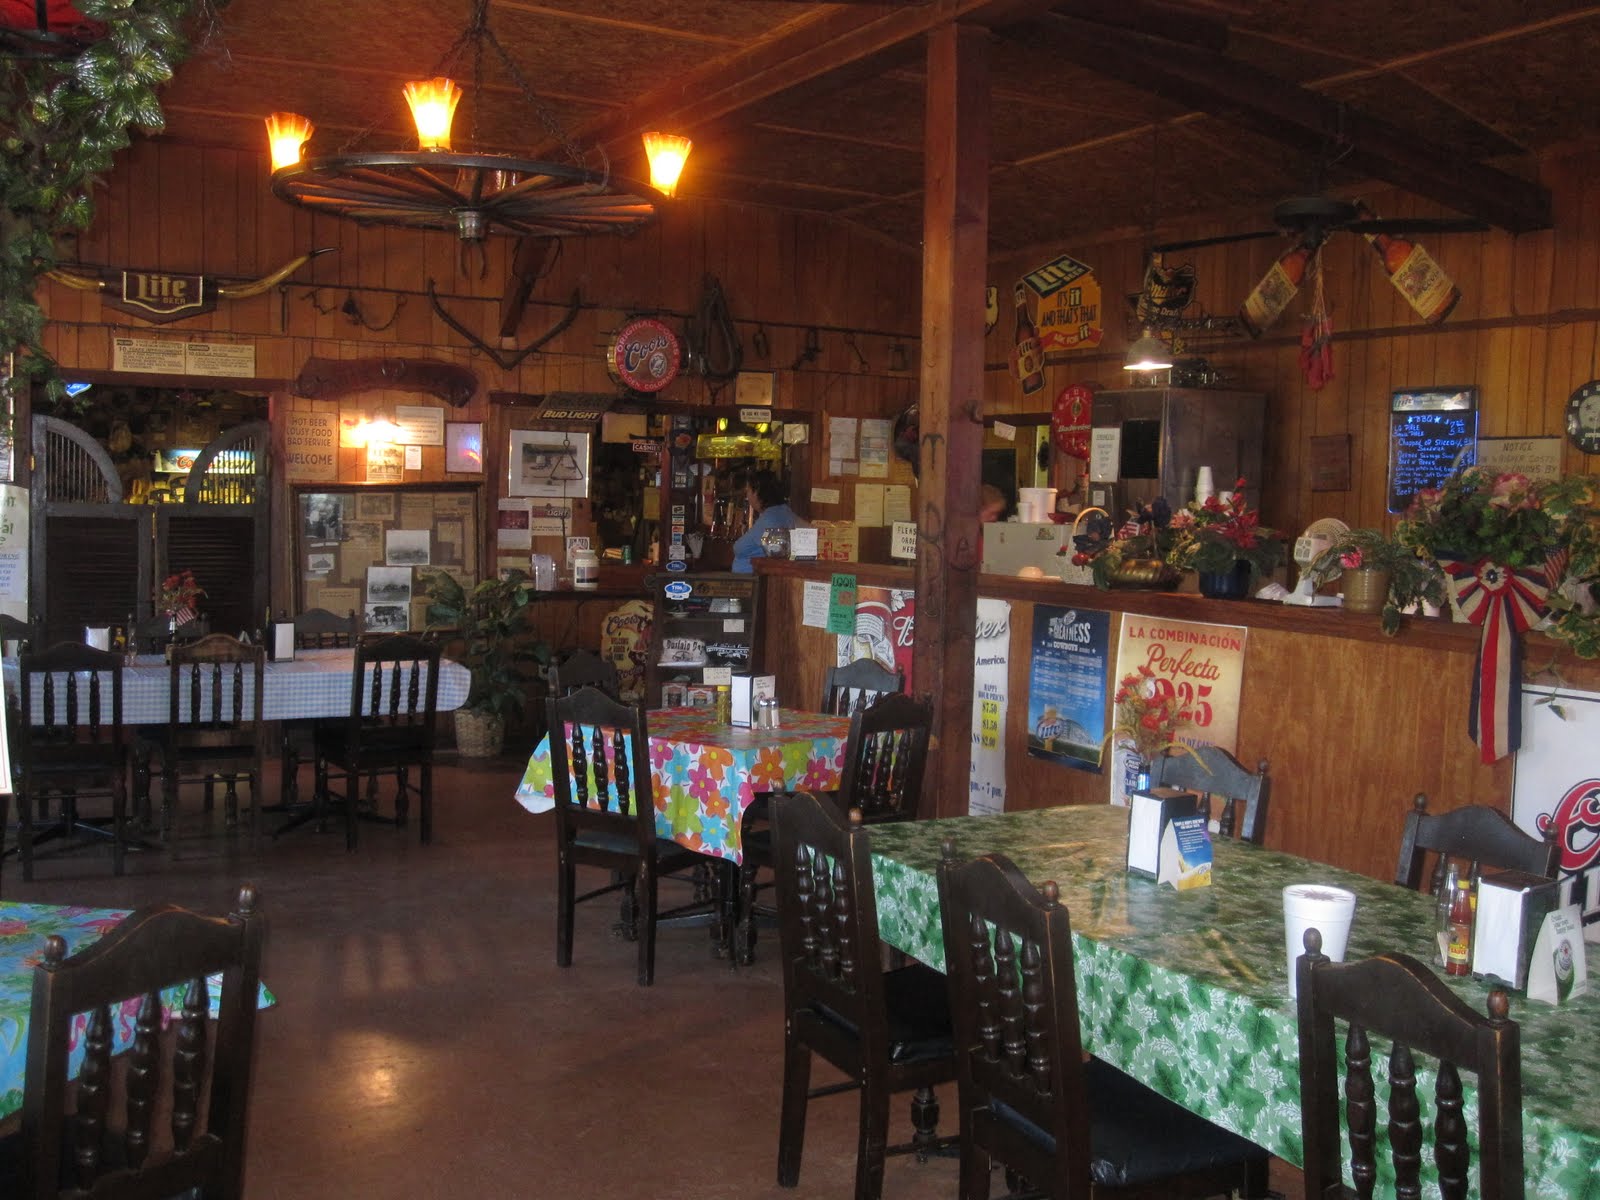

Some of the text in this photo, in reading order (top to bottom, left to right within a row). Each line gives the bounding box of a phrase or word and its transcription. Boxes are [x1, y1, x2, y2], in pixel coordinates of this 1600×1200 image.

[1027, 260, 1078, 291] Lite
[136, 274, 188, 302] Lite
[163, 297, 187, 305] BEER
[616, 319, 655, 353] ORIGINAL
[624, 335, 670, 373] Coors
[542, 410, 600, 420] BUD LIGHT
[291, 417, 328, 427] HOT BEER
[311, 428, 333, 437] FOOD
[1058, 424, 1092, 432] Budweise
[287, 437, 332, 447] BAD SERVICE
[1502, 442, 1534, 452] NOTICE
[286, 453, 333, 466] WELCOME
[897, 525, 917, 536] PLEAS
[832, 576, 856, 588] LOOK
[1129, 627, 1242, 652] LA COMBINACIÓN
[975, 655, 1006, 666] America.
[1147, 643, 1221, 681] Perfecta
